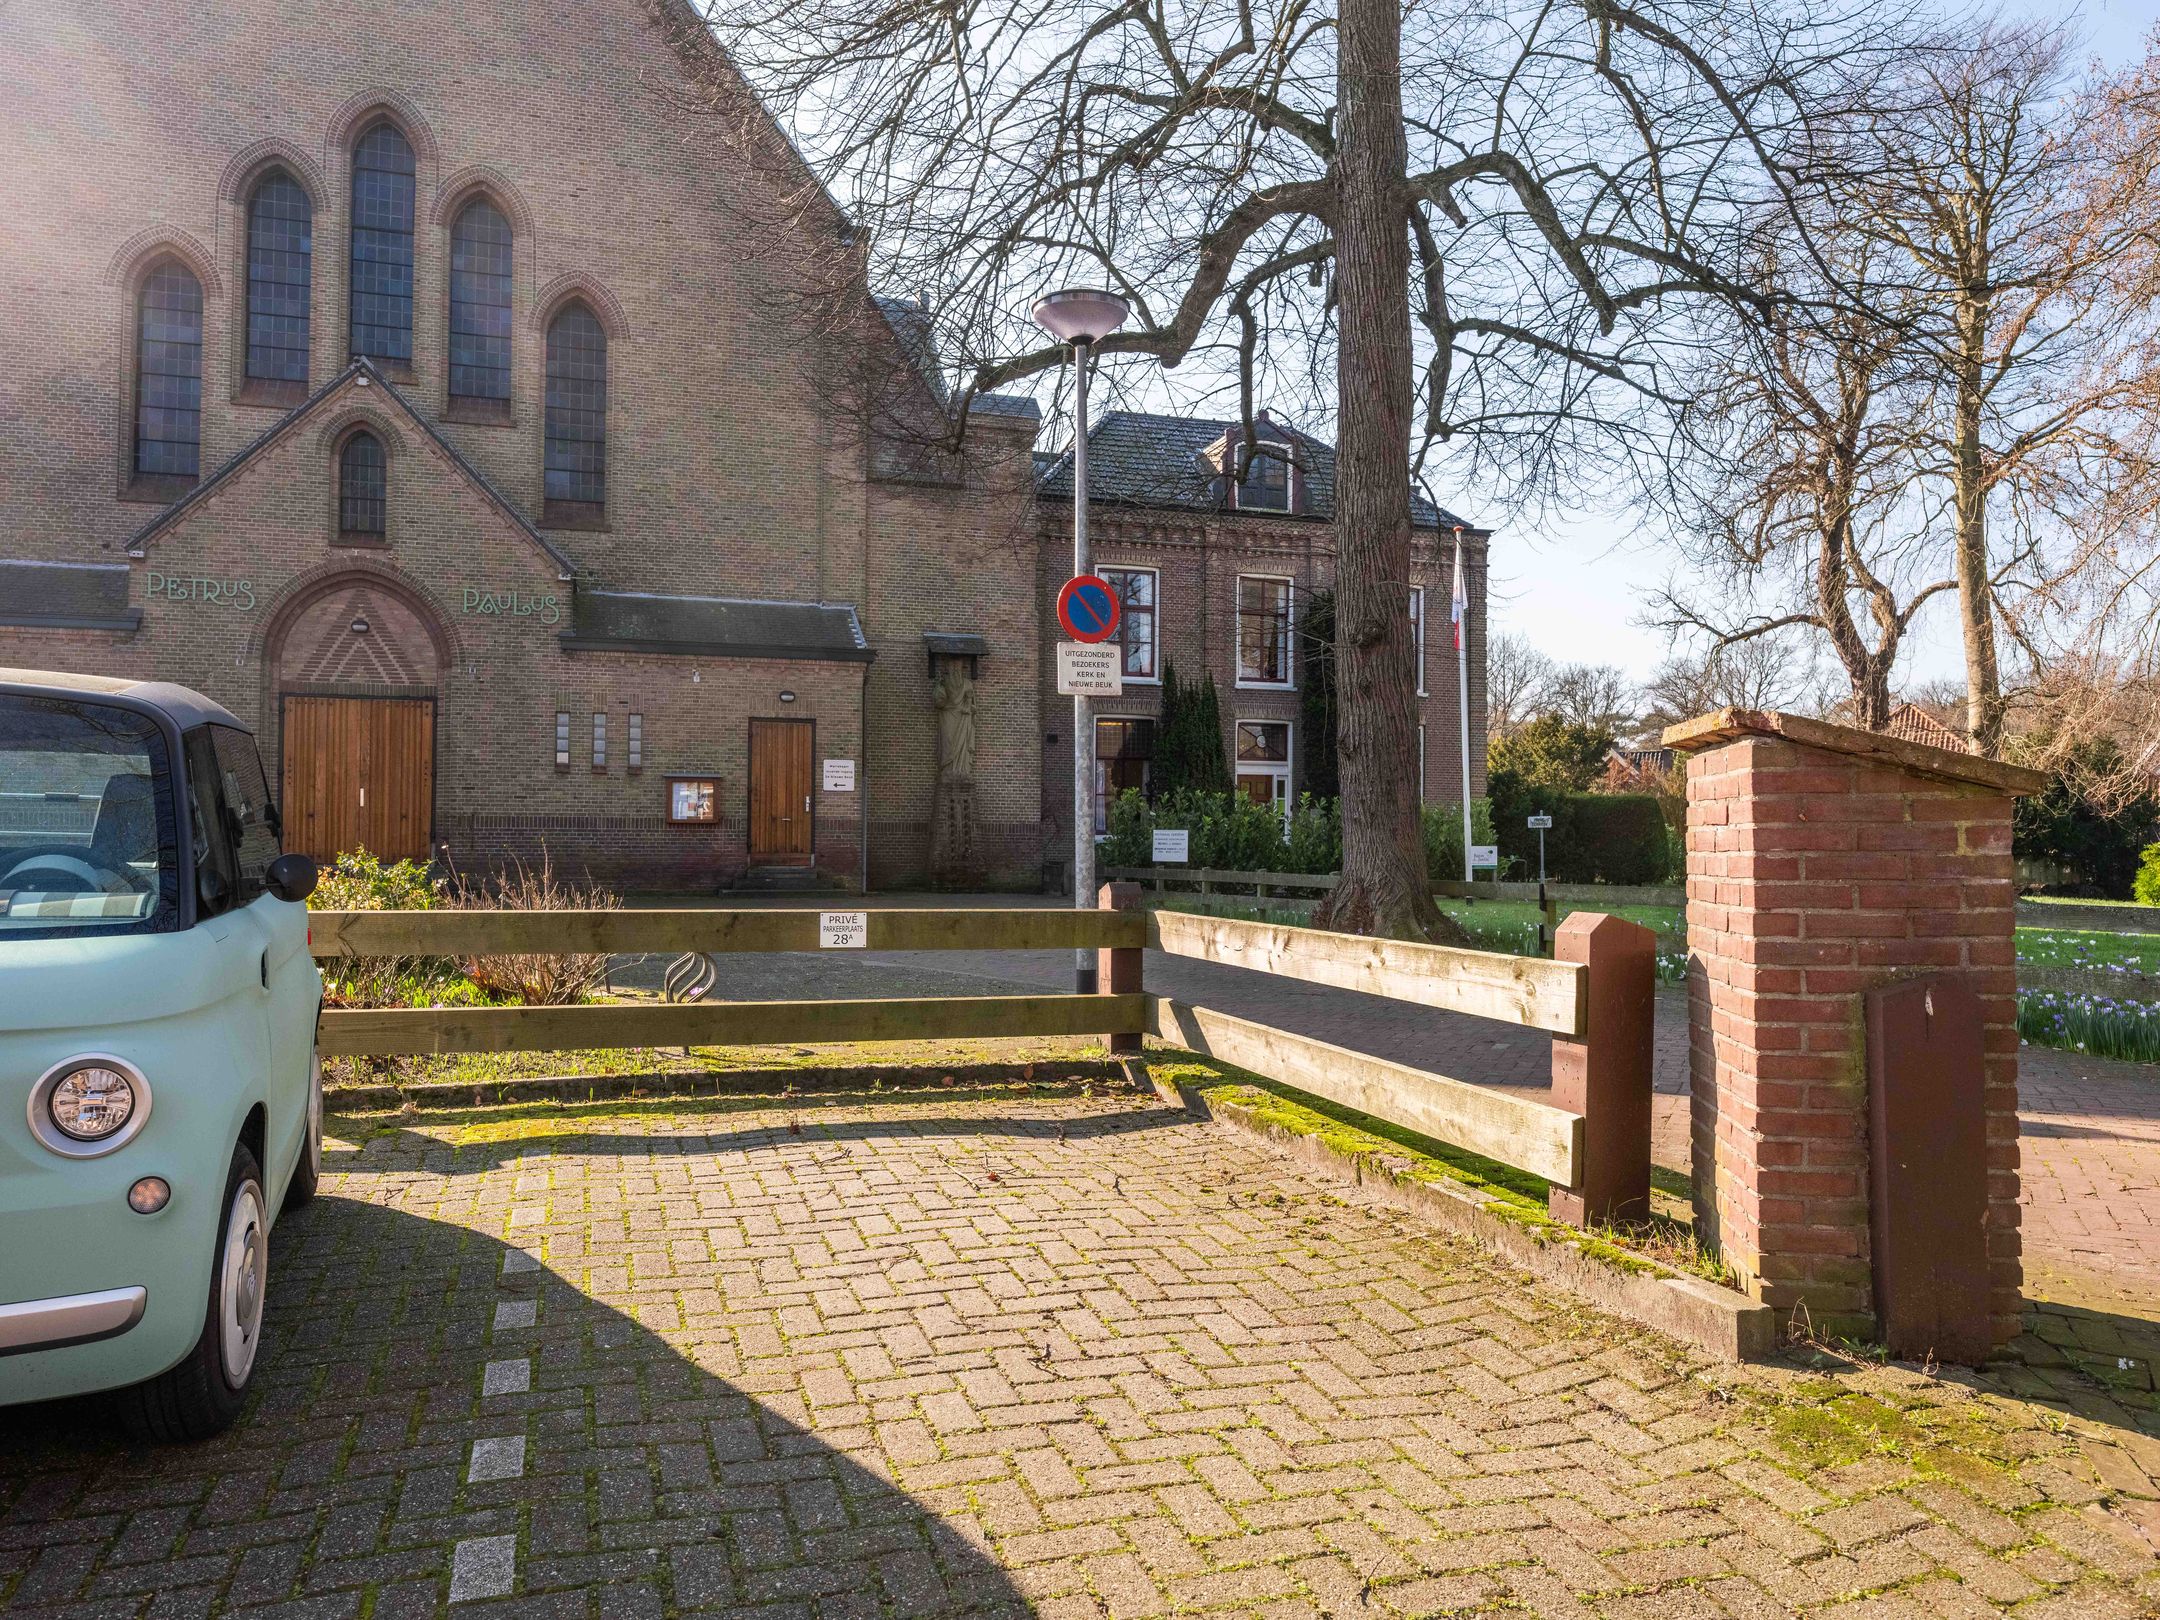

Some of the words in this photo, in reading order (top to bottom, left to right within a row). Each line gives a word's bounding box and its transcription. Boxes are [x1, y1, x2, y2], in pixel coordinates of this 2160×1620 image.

[146, 572, 255, 611] PETRUS
[462, 588, 560, 624] PAULUS
[1065, 650, 1115, 659] UITGEZONDERD
[1071, 661, 1110, 669] BEZOEKERS
[1096, 671, 1106, 679] EN
[1068, 680, 1094, 688] NIEUWE
[829, 913, 858, 924] PRIVÉ
[823, 925, 864, 933] PARKEERPLAATS
